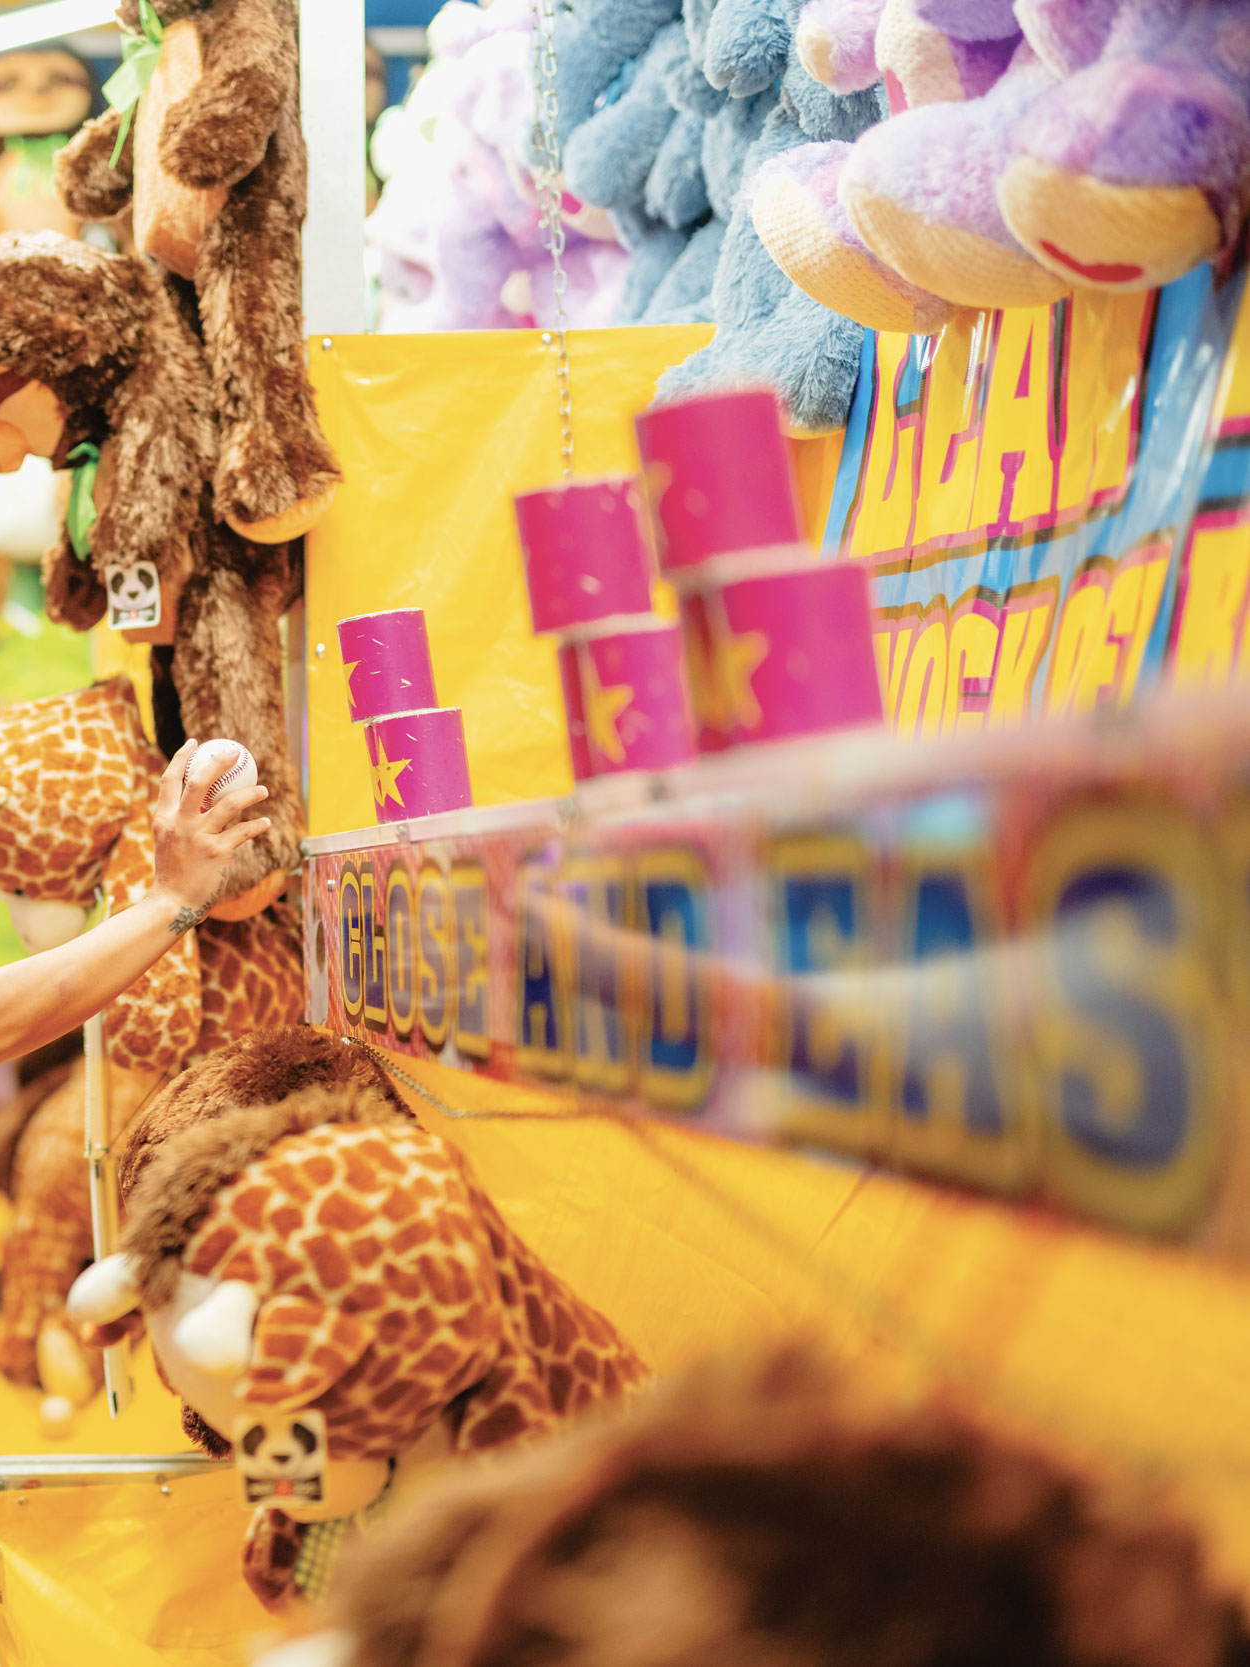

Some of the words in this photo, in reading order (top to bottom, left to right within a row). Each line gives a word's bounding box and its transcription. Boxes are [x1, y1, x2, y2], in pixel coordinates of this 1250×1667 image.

[339, 864, 491, 1048] CLOSE
[518, 853, 712, 1107] AND
[770, 803, 1250, 1228] EAS
